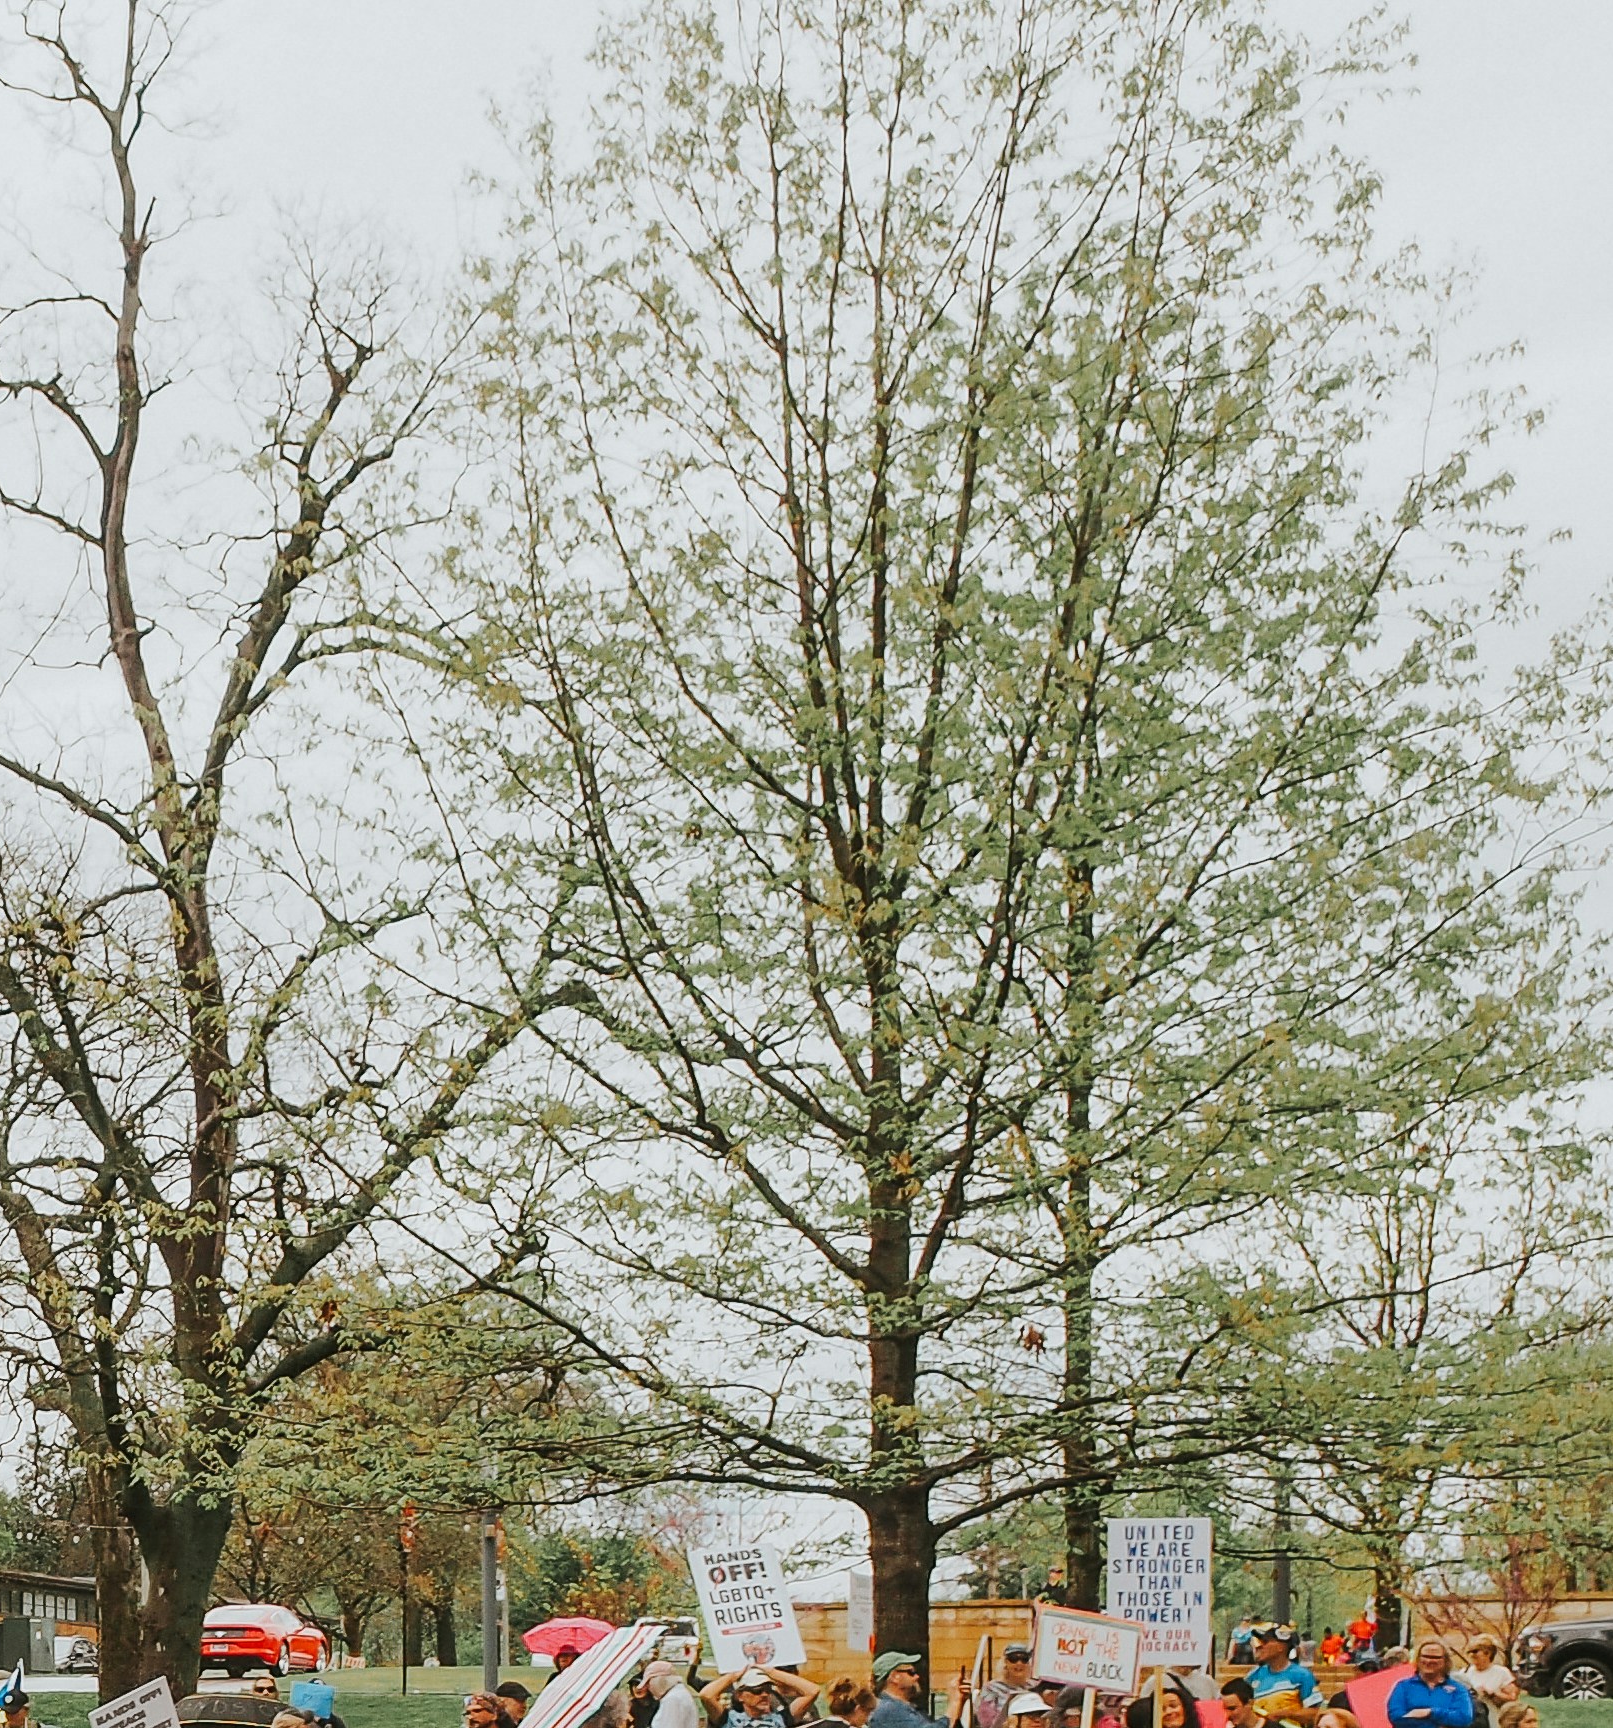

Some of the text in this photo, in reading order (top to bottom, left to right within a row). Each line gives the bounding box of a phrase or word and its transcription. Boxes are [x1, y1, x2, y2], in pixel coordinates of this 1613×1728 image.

[1124, 1525, 1194, 1541] UNITED
[703, 1548, 762, 1565] HANDS
[1127, 1542, 1192, 1557] WE ARE
[708, 1561, 768, 1585] OFF!
[1112, 1559, 1206, 1574] STRONGER
[1137, 1575, 1183, 1590] THAN
[708, 1585, 776, 1605] LGBTQ+
[1117, 1591, 1203, 1607] THOSE IN
[714, 1602, 783, 1626] RIGHTS
[1124, 1608, 1192, 1623] POWER!
[1052, 1622, 1119, 1644] ORANGE IS
[1142, 1629, 1192, 1639] VE OUR
[1057, 1637, 1120, 1661] NOT THE
[1141, 1641, 1198, 1652] OCRACY
[1053, 1660, 1124, 1682] NEW BLACK
